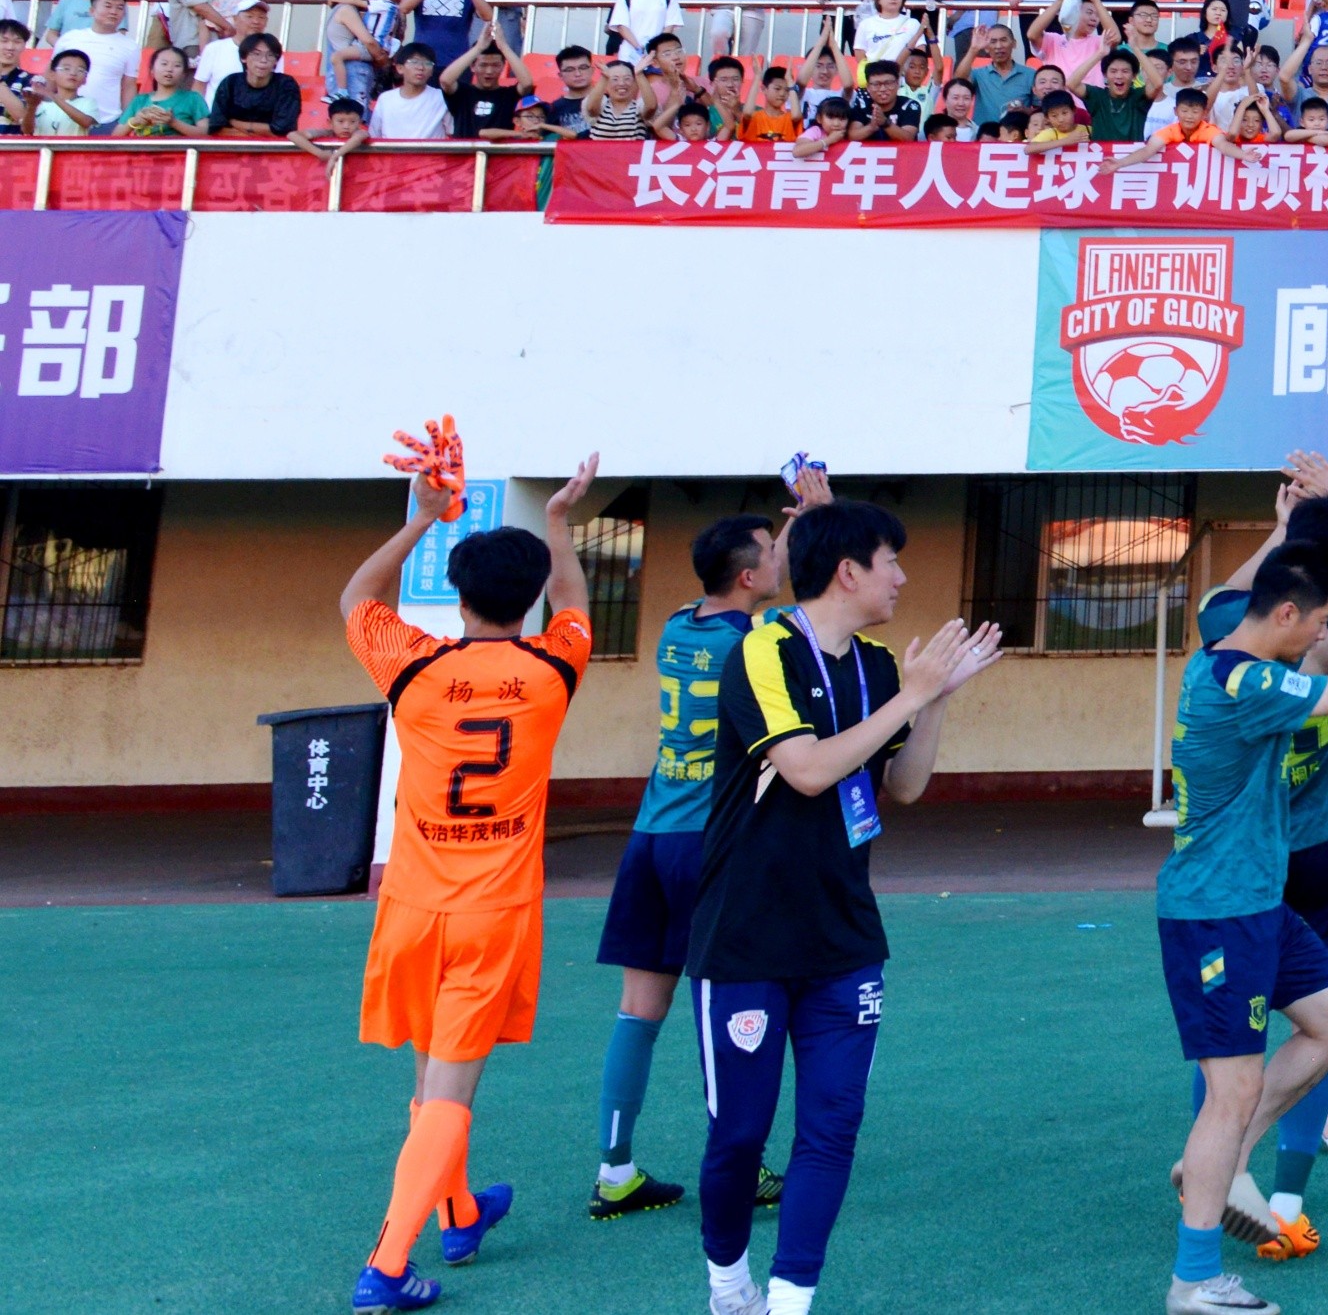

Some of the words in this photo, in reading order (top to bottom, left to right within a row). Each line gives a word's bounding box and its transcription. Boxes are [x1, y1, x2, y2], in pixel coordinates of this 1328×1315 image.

[1092, 252, 1217, 296] LANGFANG
[1067, 300, 1121, 339] CITY
[1127, 297, 1157, 327] OF
[1163, 297, 1239, 337] GLORY
[0, 283, 145, 398] 部
[443, 677, 528, 704] 杨波
[306, 738, 330, 810] 体育中心
[445, 715, 513, 819] 2
[416, 814, 527, 844] 长治华茂桐盛
